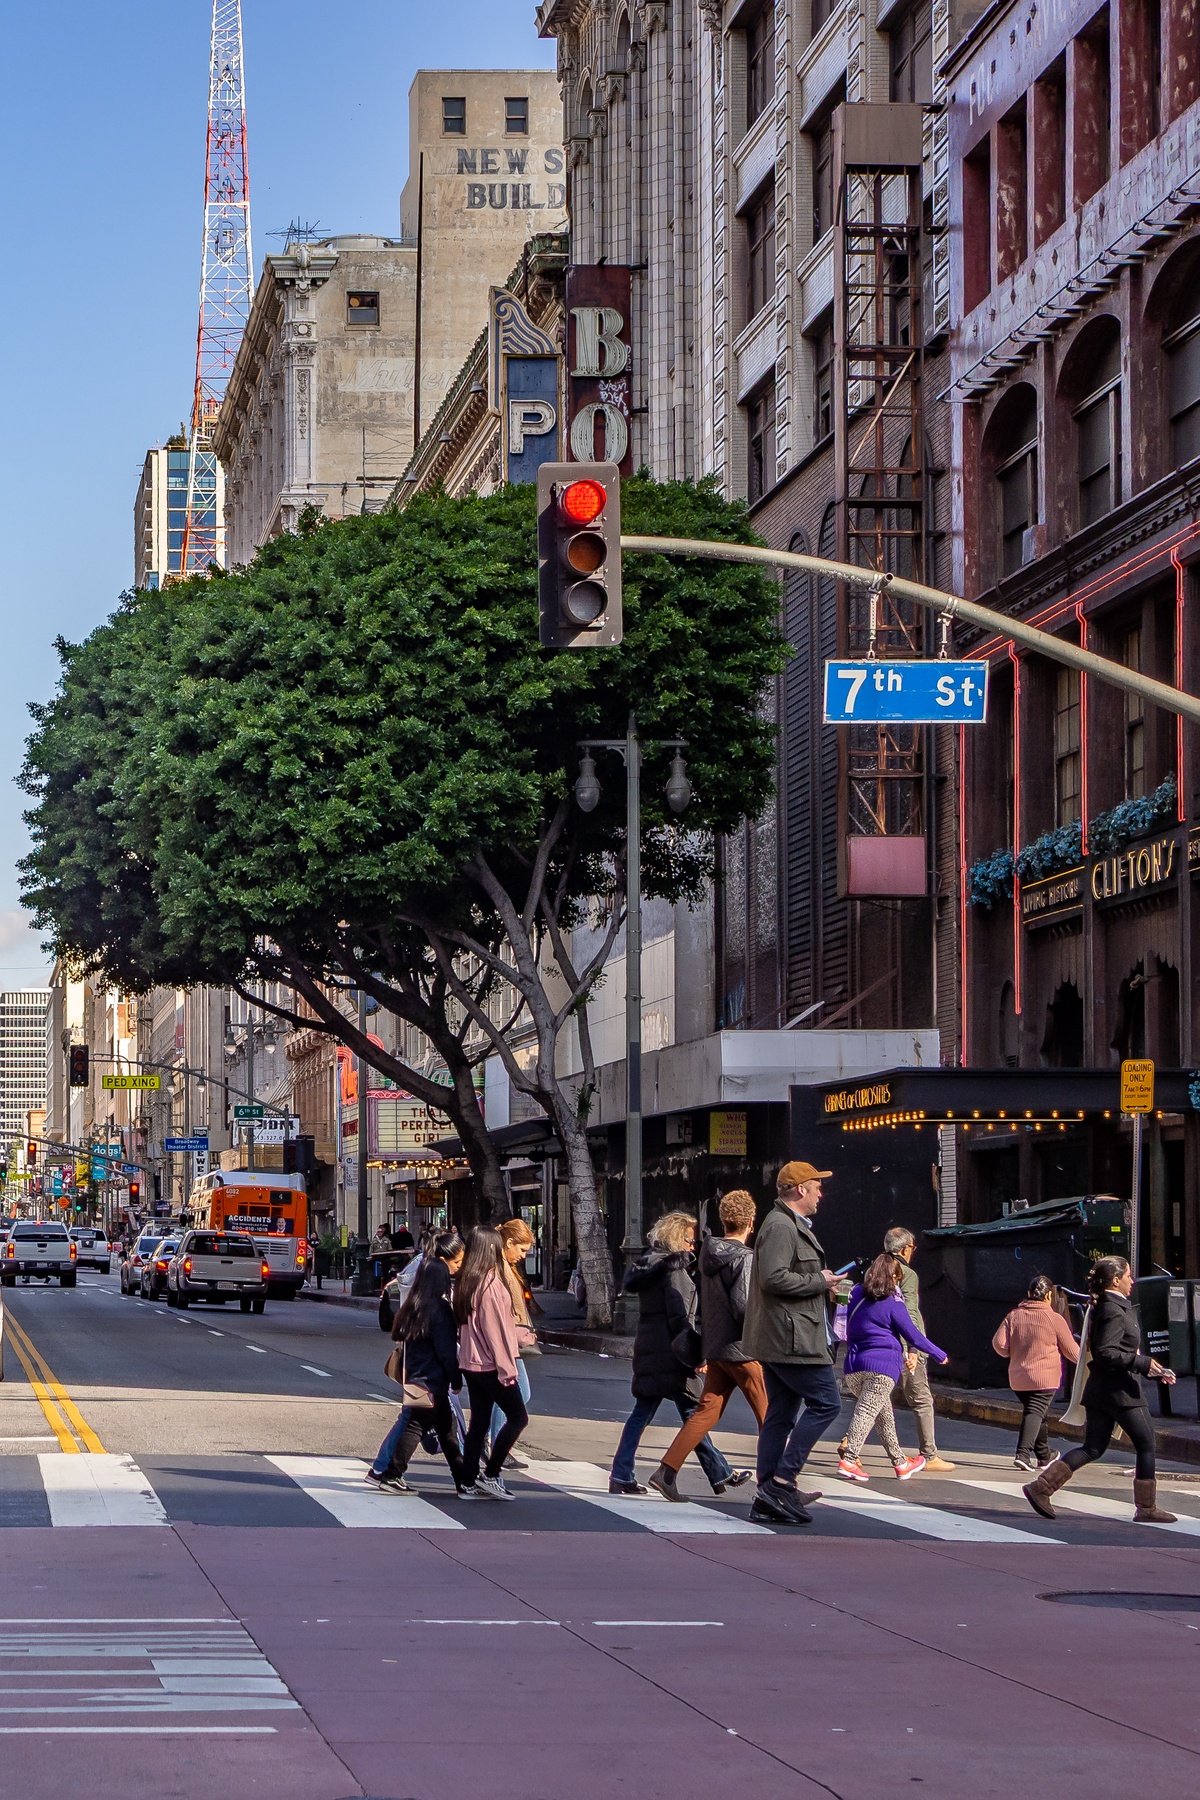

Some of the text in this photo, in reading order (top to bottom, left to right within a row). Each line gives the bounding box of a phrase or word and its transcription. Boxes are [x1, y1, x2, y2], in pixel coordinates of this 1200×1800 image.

[837, 668, 975, 714] 7th St
[1091, 838, 1175, 901] CLIFTON'S
[1023, 877, 1079, 915] LIVING HISTORY
[1124, 1063, 1152, 1073] LOADING
[107, 1077, 156, 1087] PED XING
[1129, 1073, 1147, 1083] ONLY
[824, 1090, 847, 1113] CABINET
[854, 1082, 891, 1108] CURIOSITIES
[238, 1108, 251, 1116] 6th
[401, 1120, 453, 1131] PERFECT
[93, 1145, 121, 1157] dogs!
[228, 1214, 272, 1224] ACCIDENTS
